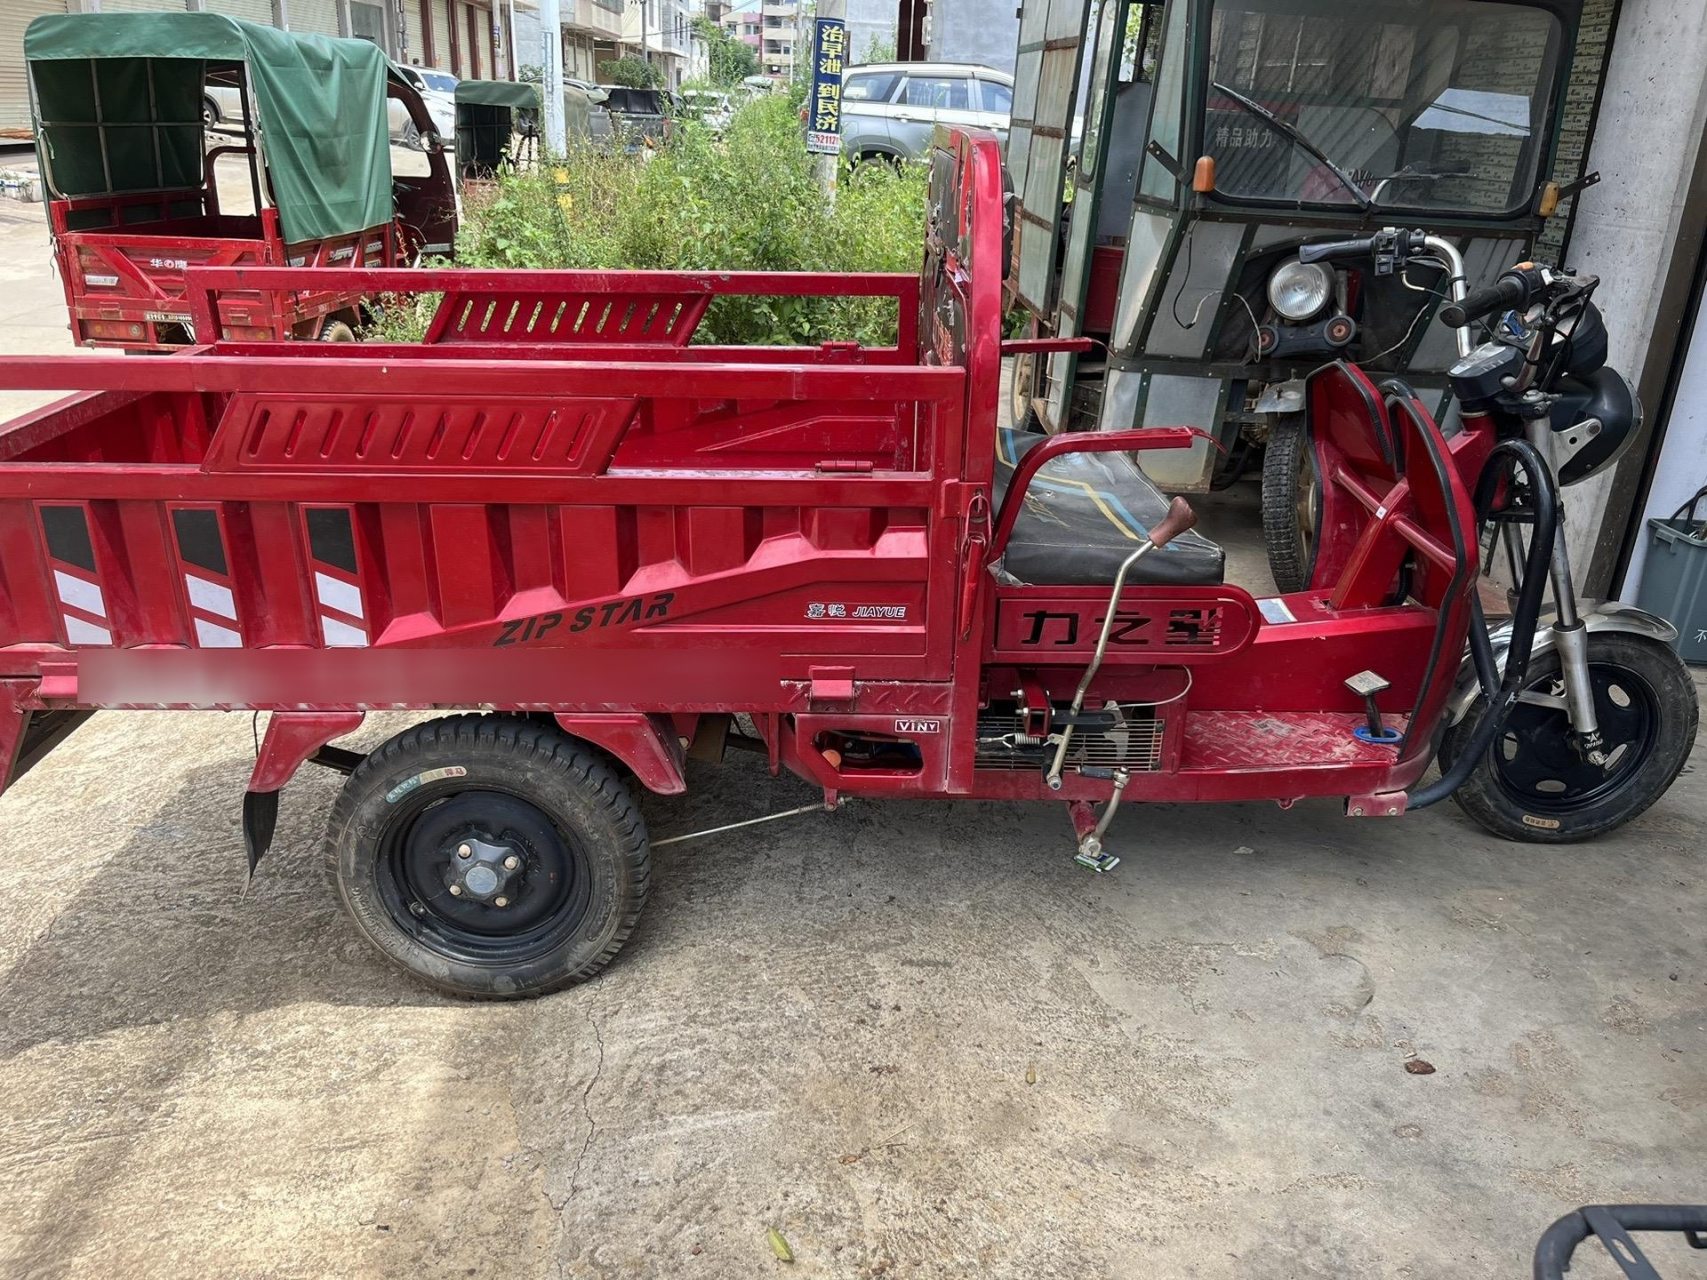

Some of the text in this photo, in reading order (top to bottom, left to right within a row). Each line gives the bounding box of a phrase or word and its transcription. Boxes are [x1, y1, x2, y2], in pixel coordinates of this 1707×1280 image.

[818, 25, 844, 75] 治早泄
[815, 83, 840, 131] 到民济
[1215, 126, 1273, 148] 精品助力
[493, 592, 675, 647] ZIP STAR
[852, 606, 906, 618] JIAYUE
